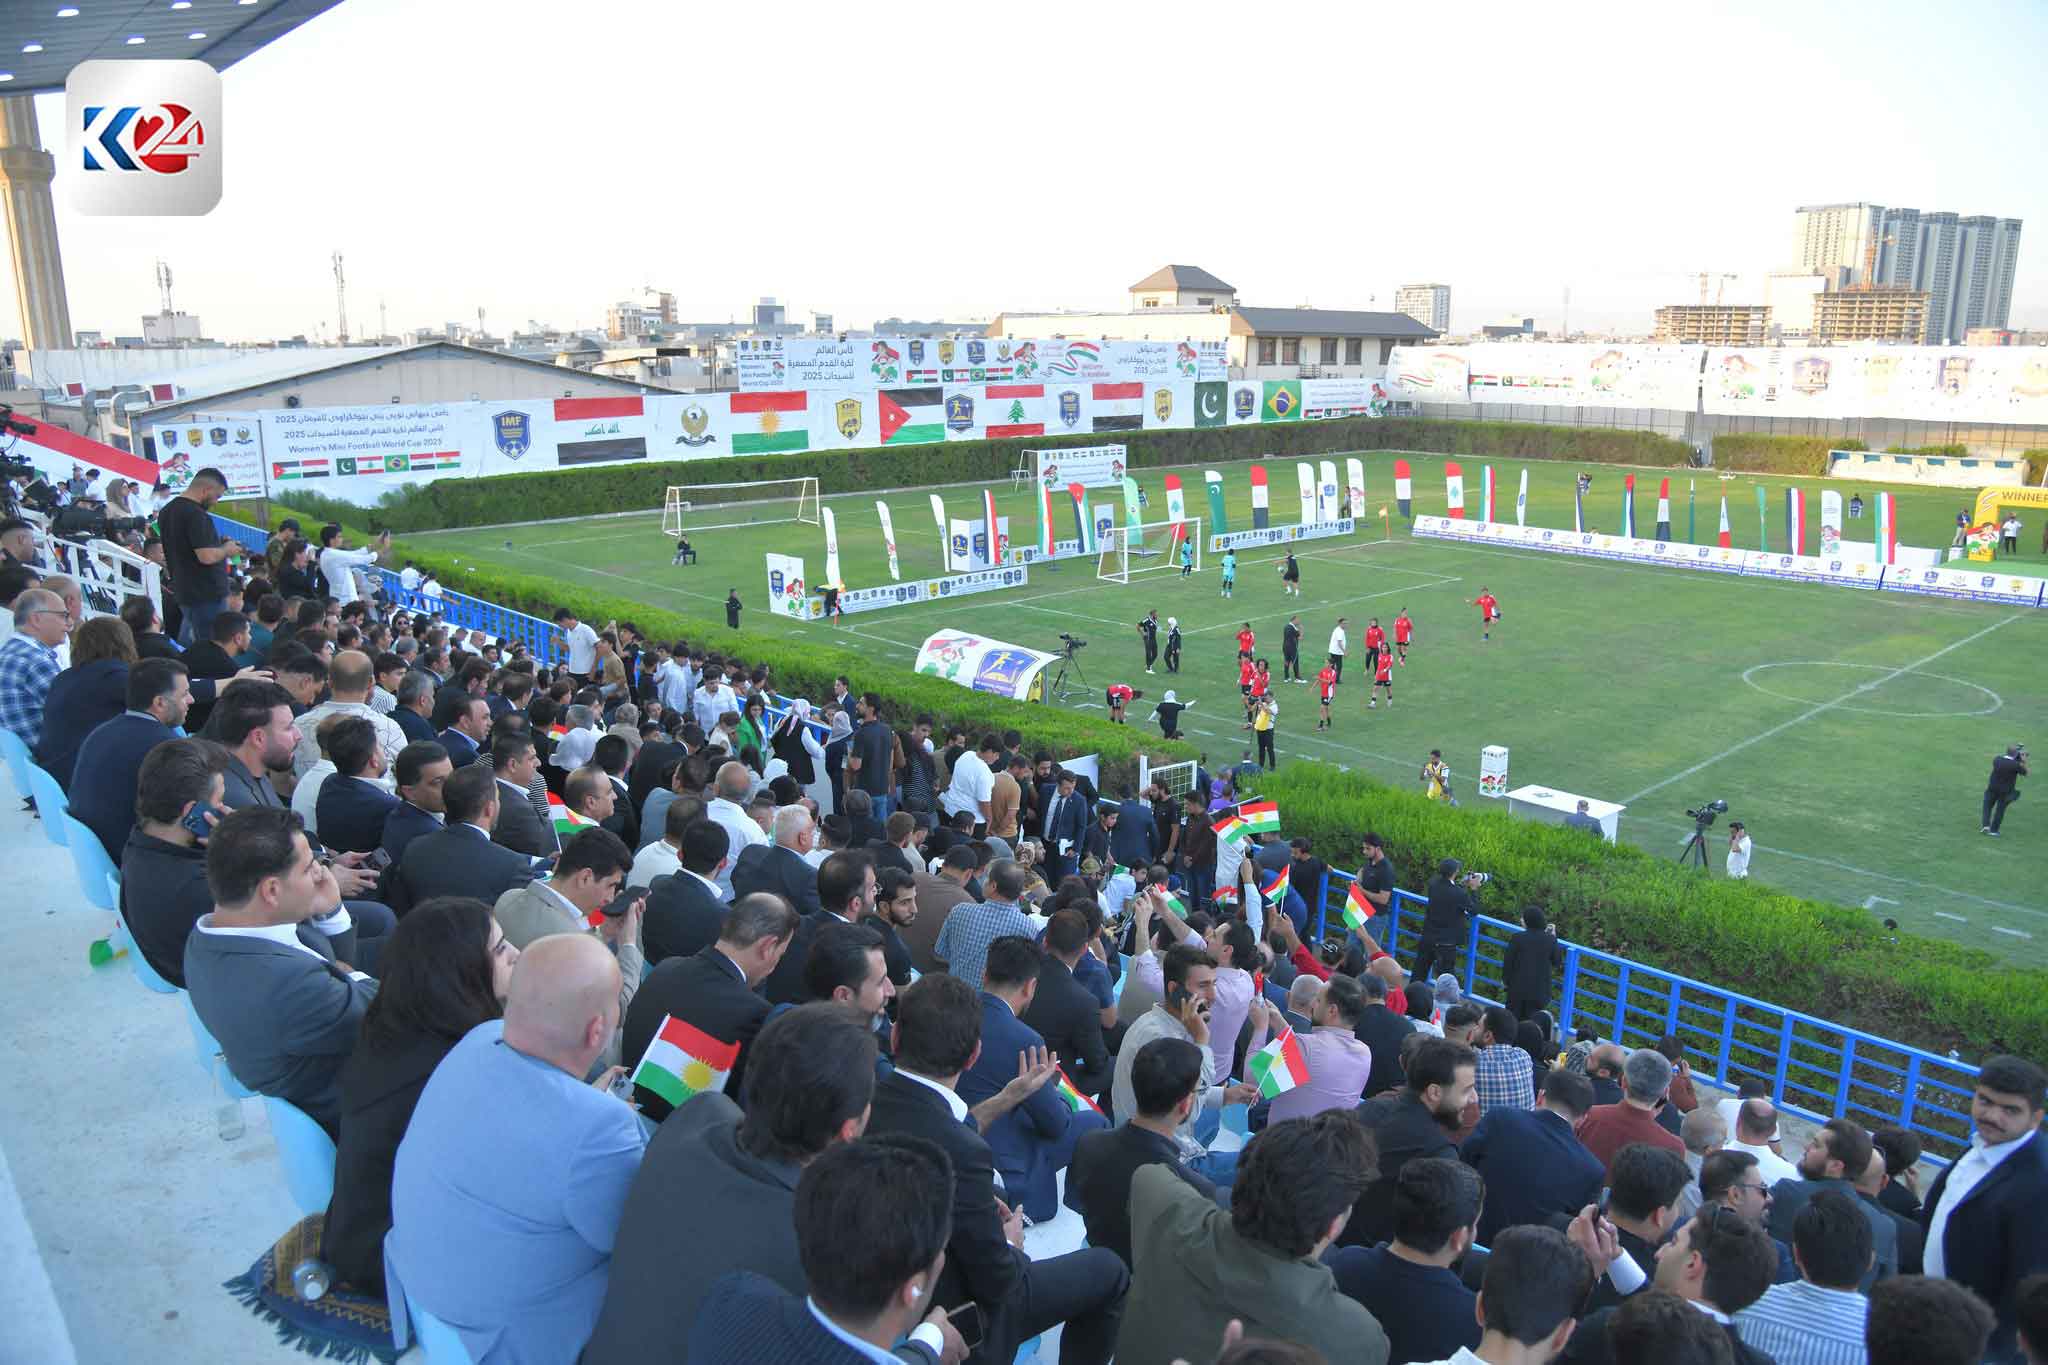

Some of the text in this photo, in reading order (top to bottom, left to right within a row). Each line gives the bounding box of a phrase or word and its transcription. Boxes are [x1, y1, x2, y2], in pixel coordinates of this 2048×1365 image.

[802, 371, 823, 381] 2025
[275, 415, 297, 424] 2025
[501, 415, 522, 426] IMF
[283, 430, 306, 439] 2025
[288, 445, 328, 454] Women's
[347, 441, 381, 451] Football
[381, 439, 406, 449] World
[406, 439, 423, 449] Cup
[423, 437, 443, 447] 2025
